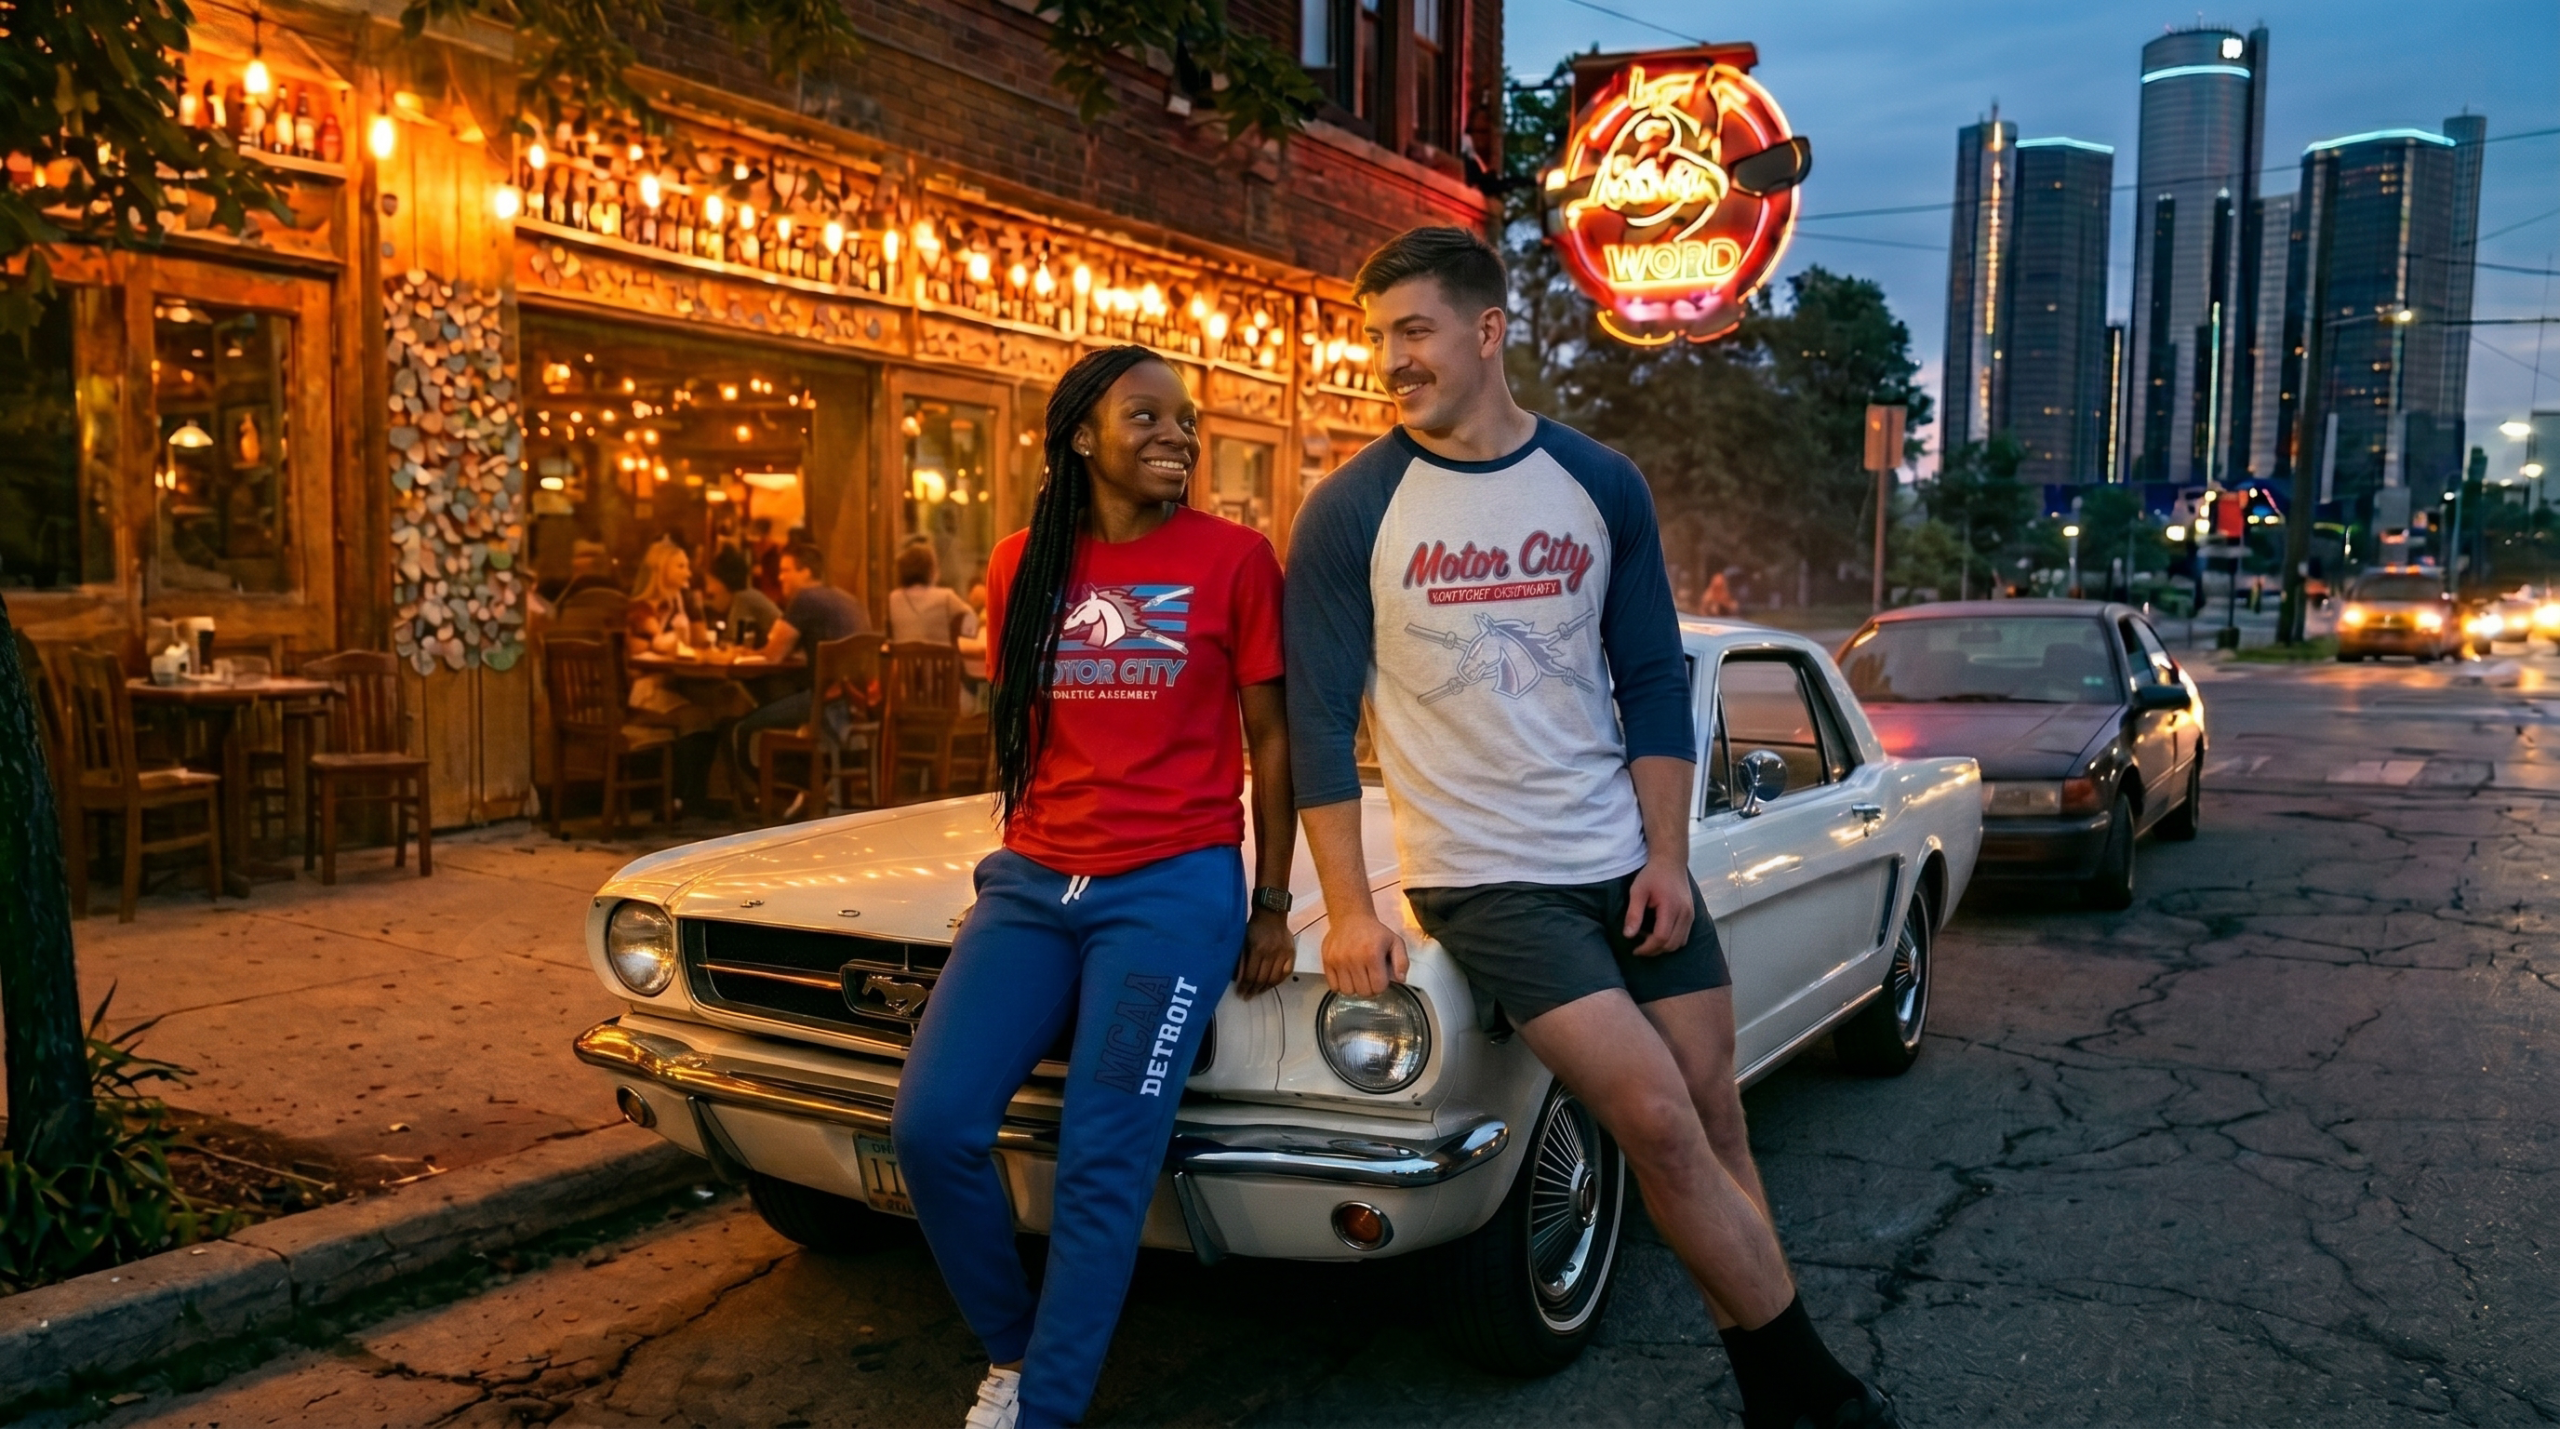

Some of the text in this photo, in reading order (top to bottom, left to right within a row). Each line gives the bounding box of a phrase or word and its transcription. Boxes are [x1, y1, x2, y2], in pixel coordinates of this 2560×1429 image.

[1403, 530, 1595, 595] Motor City
[1120, 658, 1187, 687] CITY
[1095, 973, 1171, 1094] MCAA
[1140, 976, 1198, 1097] DETROIT
